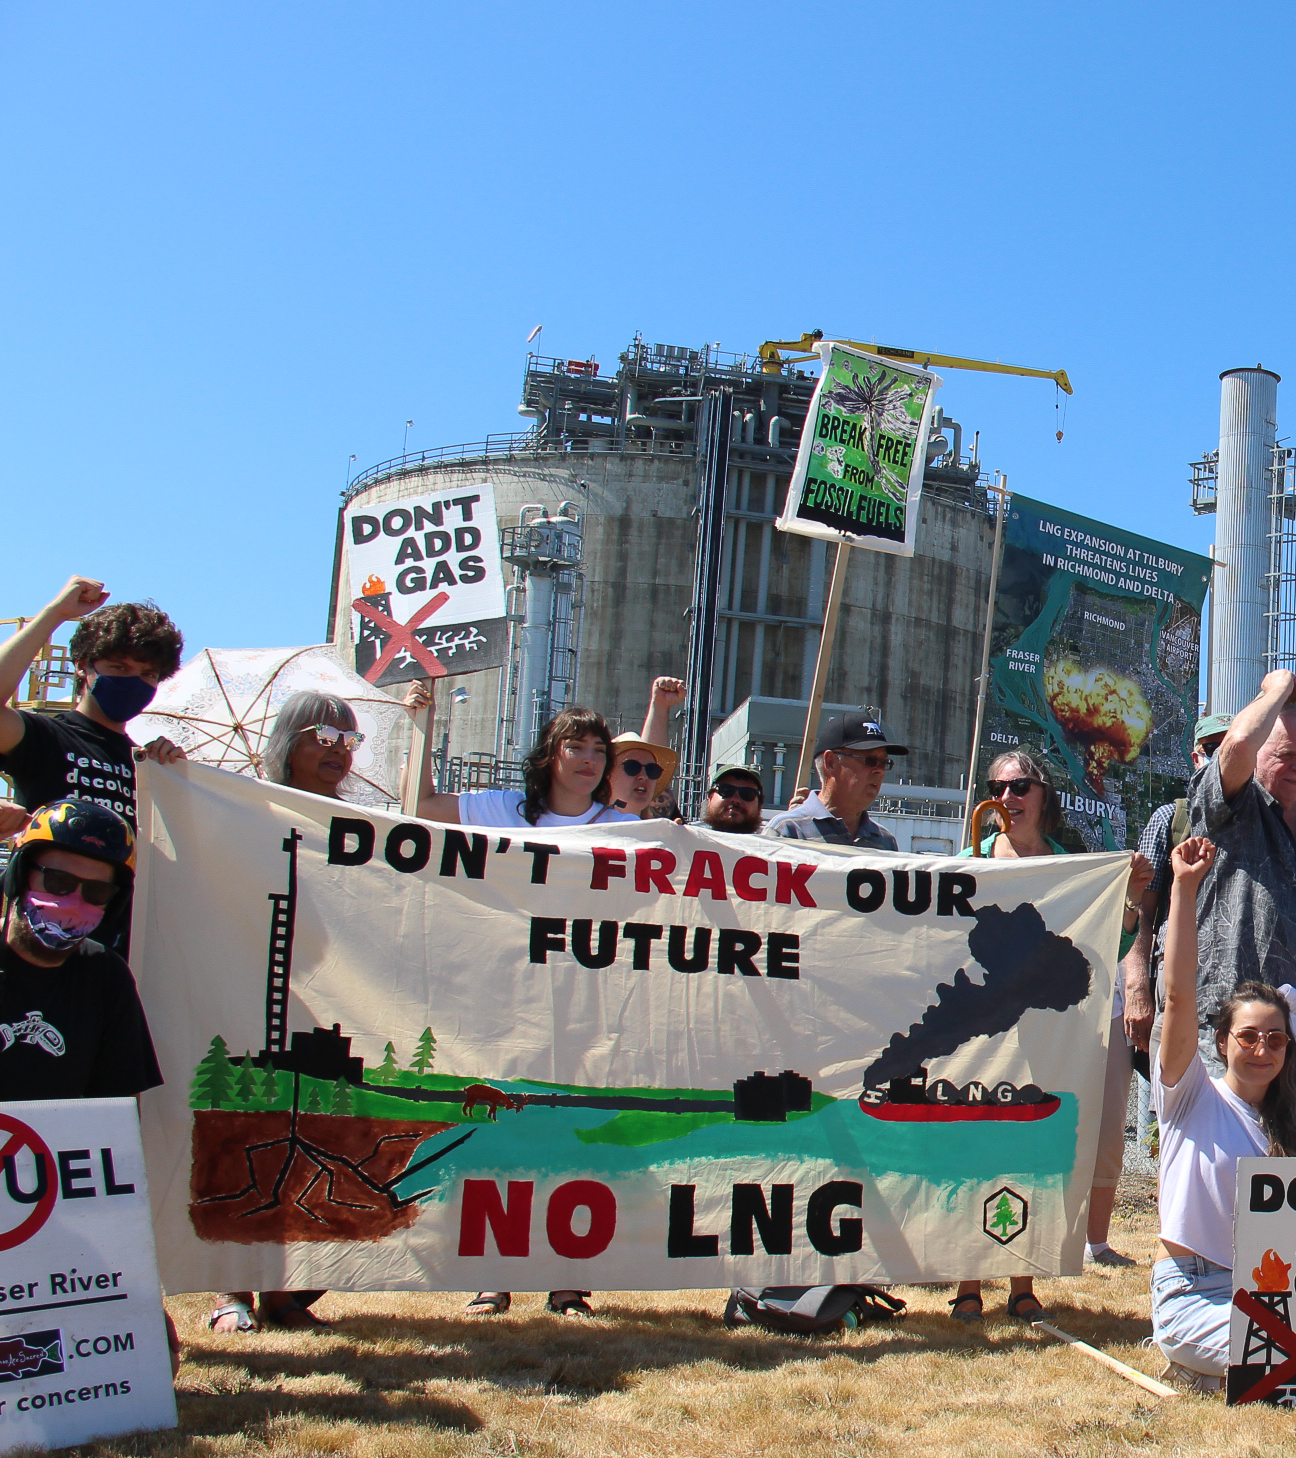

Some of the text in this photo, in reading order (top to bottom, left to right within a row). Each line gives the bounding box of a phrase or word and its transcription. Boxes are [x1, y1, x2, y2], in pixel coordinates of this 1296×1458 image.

[818, 414, 912, 468] BREAK FREE
[843, 464, 875, 490] FROM
[352, 494, 481, 545] DON'T
[802, 477, 905, 531] FOSSIL FUELS
[395, 526, 482, 565] ADD
[1039, 519, 1184, 577] LNG EXPANSION AT TILBURY
[396, 555, 487, 595] GAS
[1042, 553, 1174, 604] IN RICHMOND AND DELTA
[1065, 544, 1158, 582] THREATENS LIVES
[1084, 611, 1126, 631] RICHMOND
[1006, 648, 1040, 663] FRASER
[1161, 630, 1199, 652] VANCOUVER
[1166, 643, 1193, 661] AIRPORT
[1008, 661, 1037, 674] RIVER
[990, 732, 1019, 745] DELTA
[328, 816, 978, 917] DON'T FRACK OUR
[529, 916, 801, 980] FUTURE
[457, 1178, 865, 1260] NO LNG
[50, 1268, 122, 1295] River
[18, 1350, 44, 1363] Sacred
[69, 1332, 136, 1360] .COM
[17, 1380, 132, 1411] concerns
